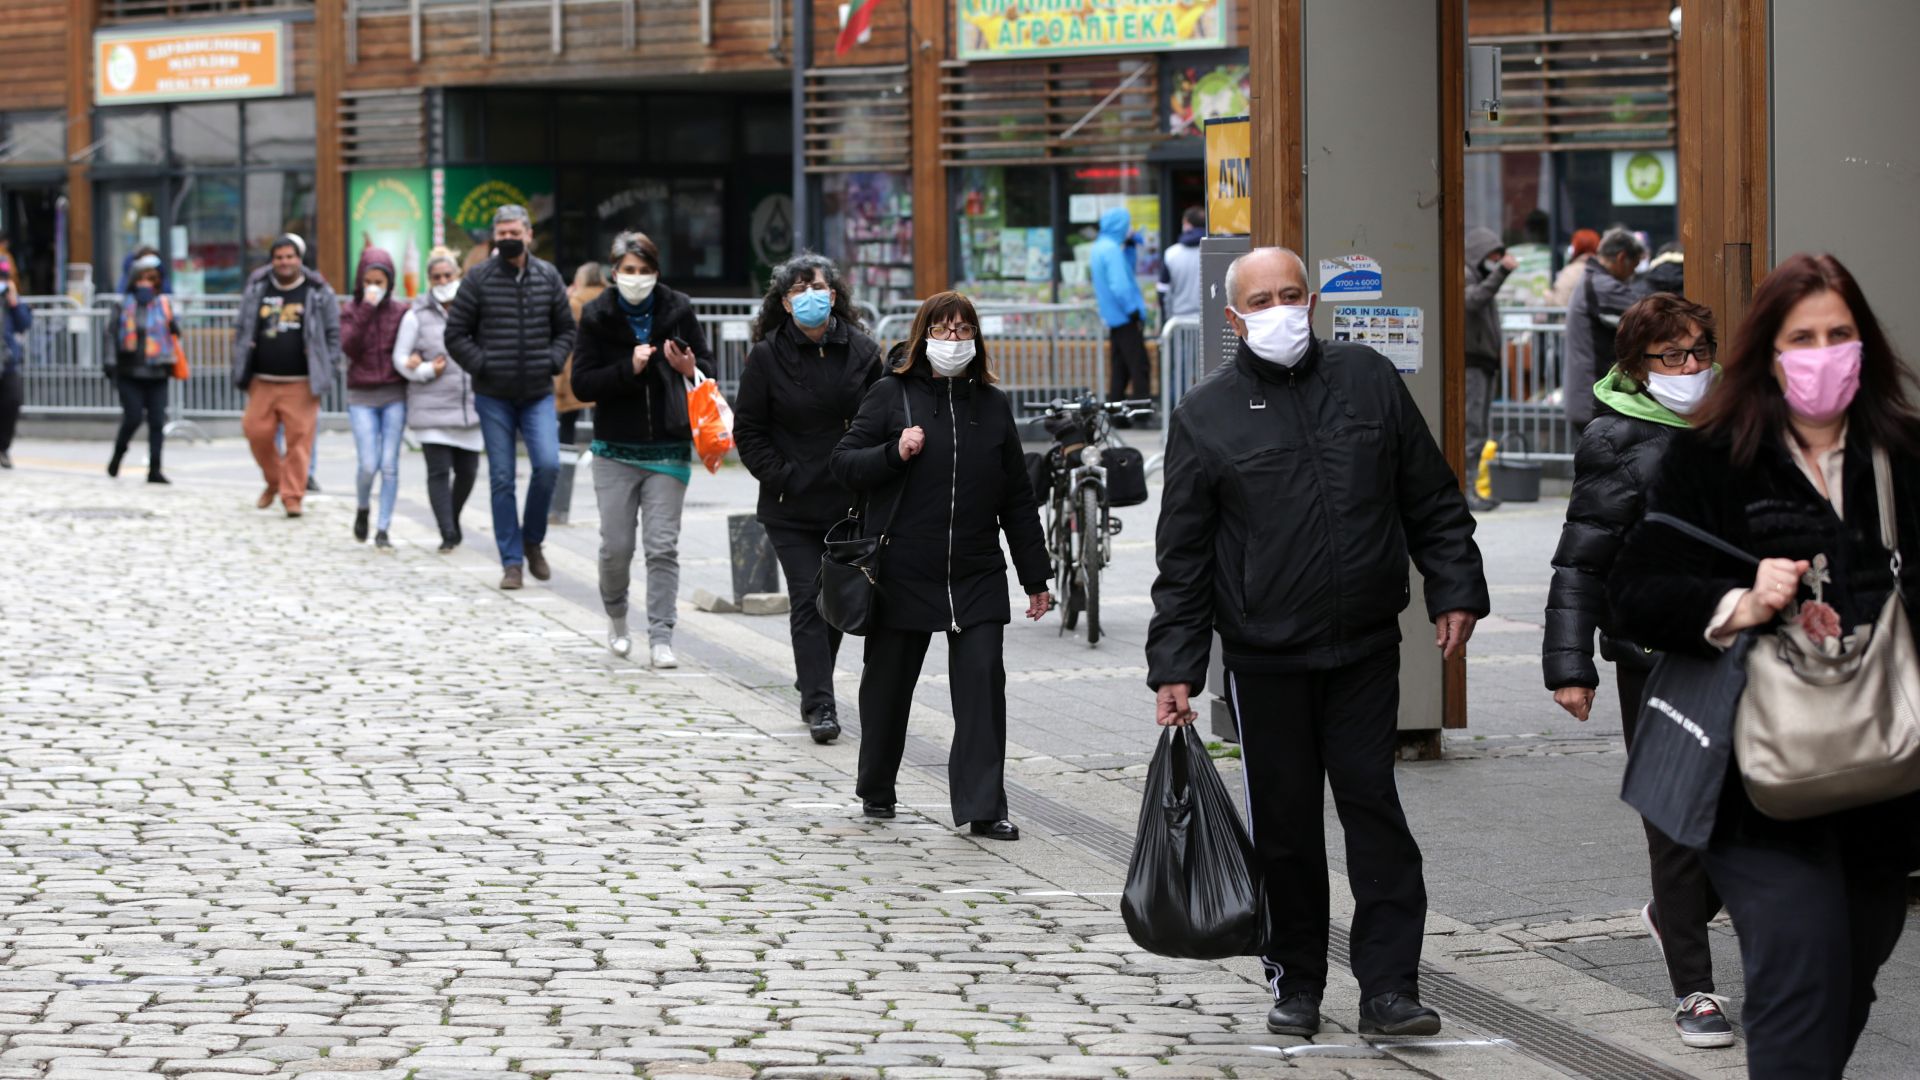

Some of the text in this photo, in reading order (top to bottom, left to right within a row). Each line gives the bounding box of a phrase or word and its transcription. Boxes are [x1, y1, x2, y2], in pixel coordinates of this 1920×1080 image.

[1000, 12, 1177, 45] АГРОАПТЕКА
[1219, 158, 1250, 198] ATM
[1341, 308, 1357, 316] JOB
[1361, 308, 1370, 316] IN
[1374, 308, 1399, 316] ISRAEL
